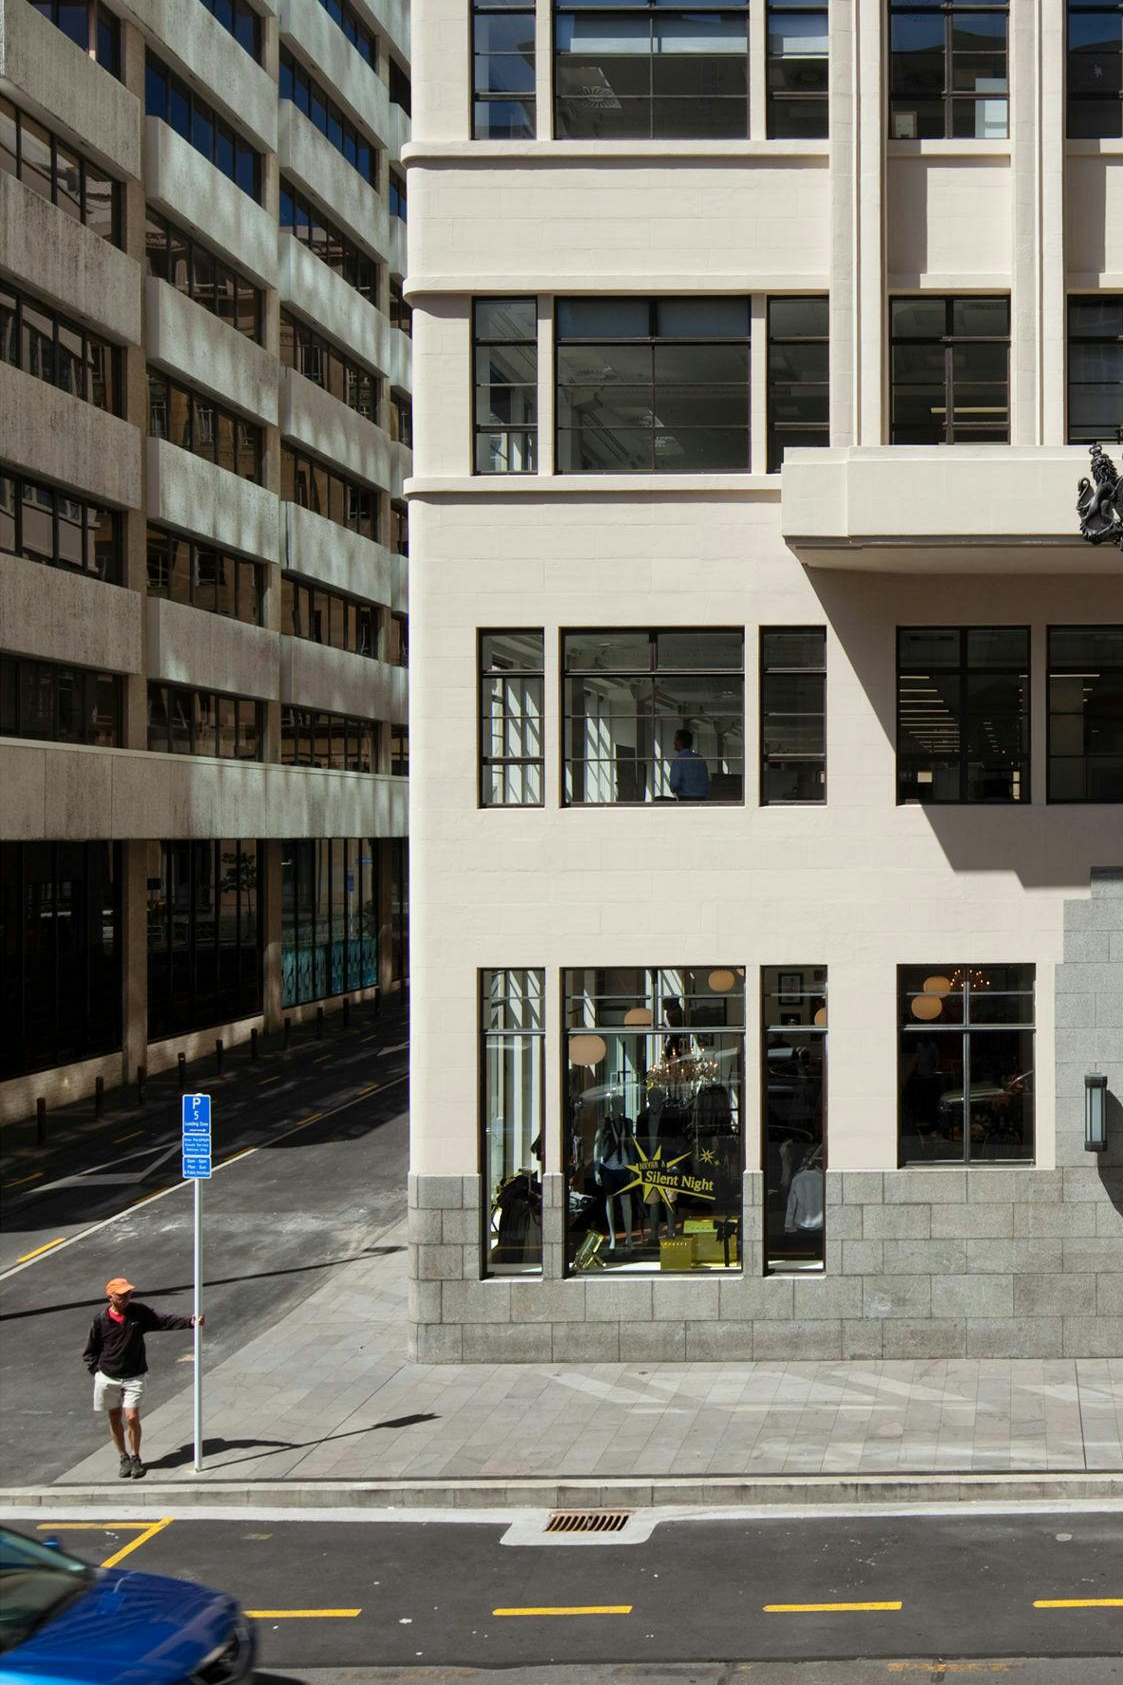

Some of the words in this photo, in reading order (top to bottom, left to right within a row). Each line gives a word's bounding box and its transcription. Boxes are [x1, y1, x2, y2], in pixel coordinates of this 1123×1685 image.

[192, 1097, 201, 1109] P
[193, 1110, 199, 1120] 5
[645, 1170, 679, 1186] Silent
[681, 1175, 714, 1192] Night
